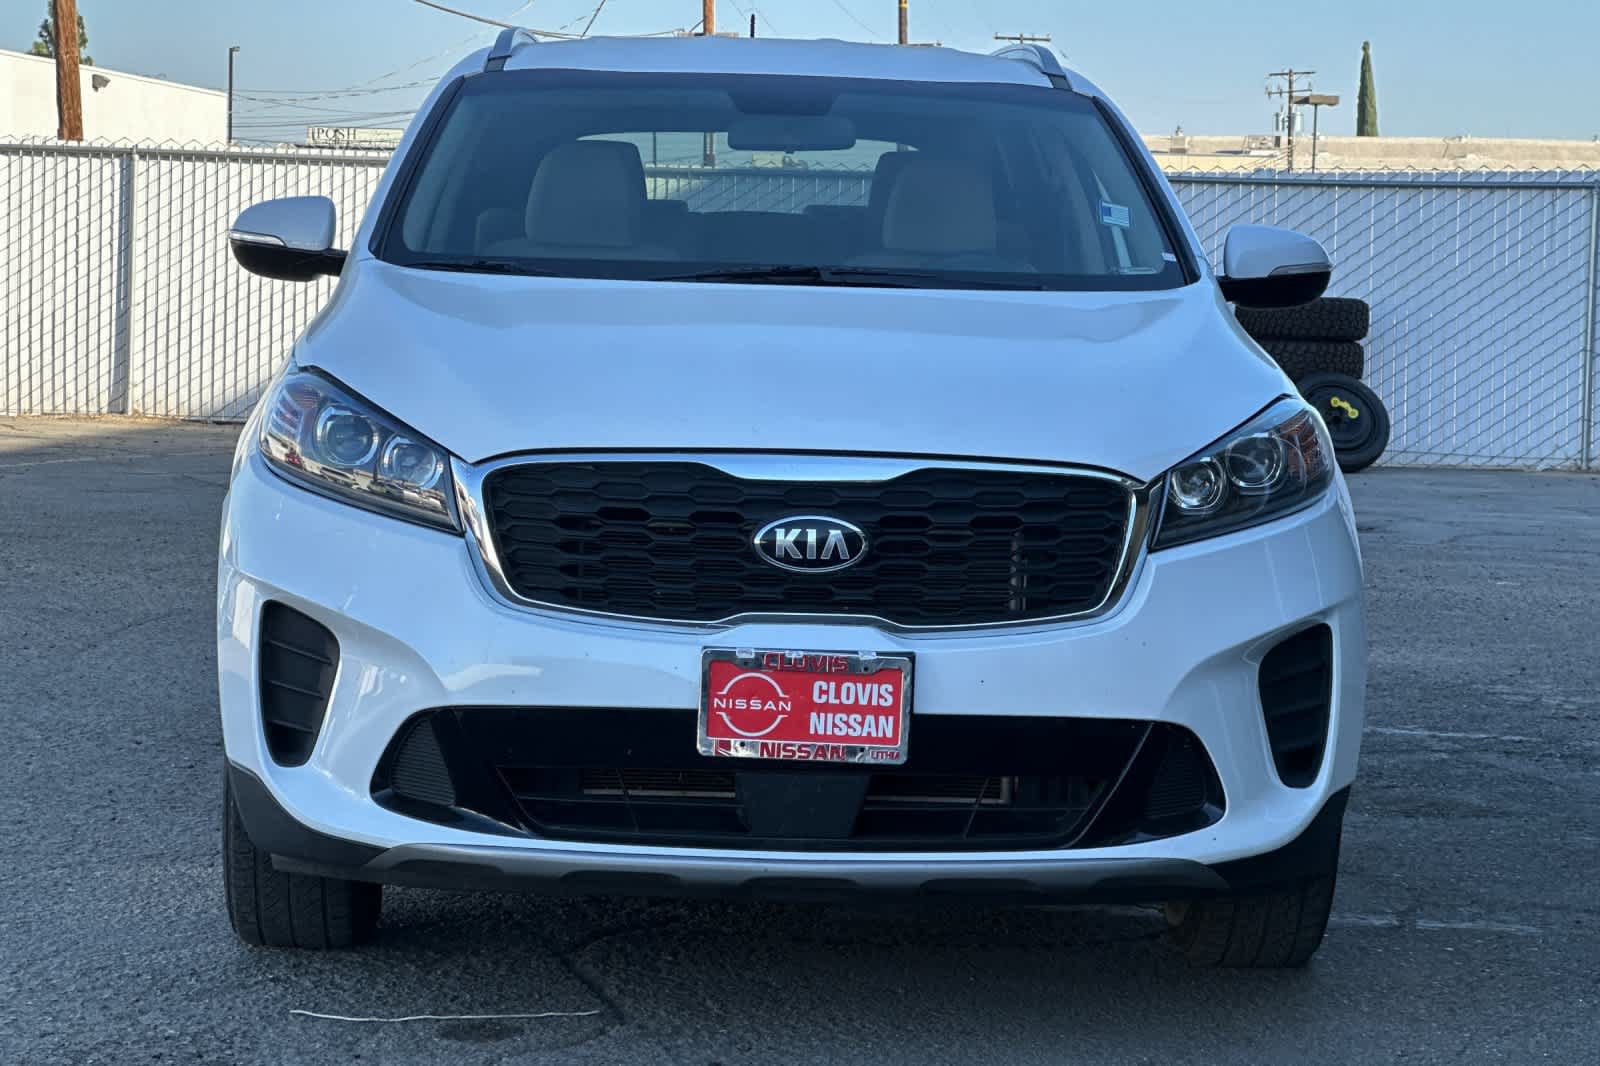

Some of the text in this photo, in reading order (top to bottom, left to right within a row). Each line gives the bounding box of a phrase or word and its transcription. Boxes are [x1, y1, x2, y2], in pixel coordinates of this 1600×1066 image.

[775, 528, 850, 559] KIA
[764, 652, 849, 672] CLOVIS
[713, 698, 792, 711] NISSAN
[812, 680, 894, 706] CLOVIS
[809, 712, 894, 738] NISSAN
[759, 741, 846, 760] NISSAN
